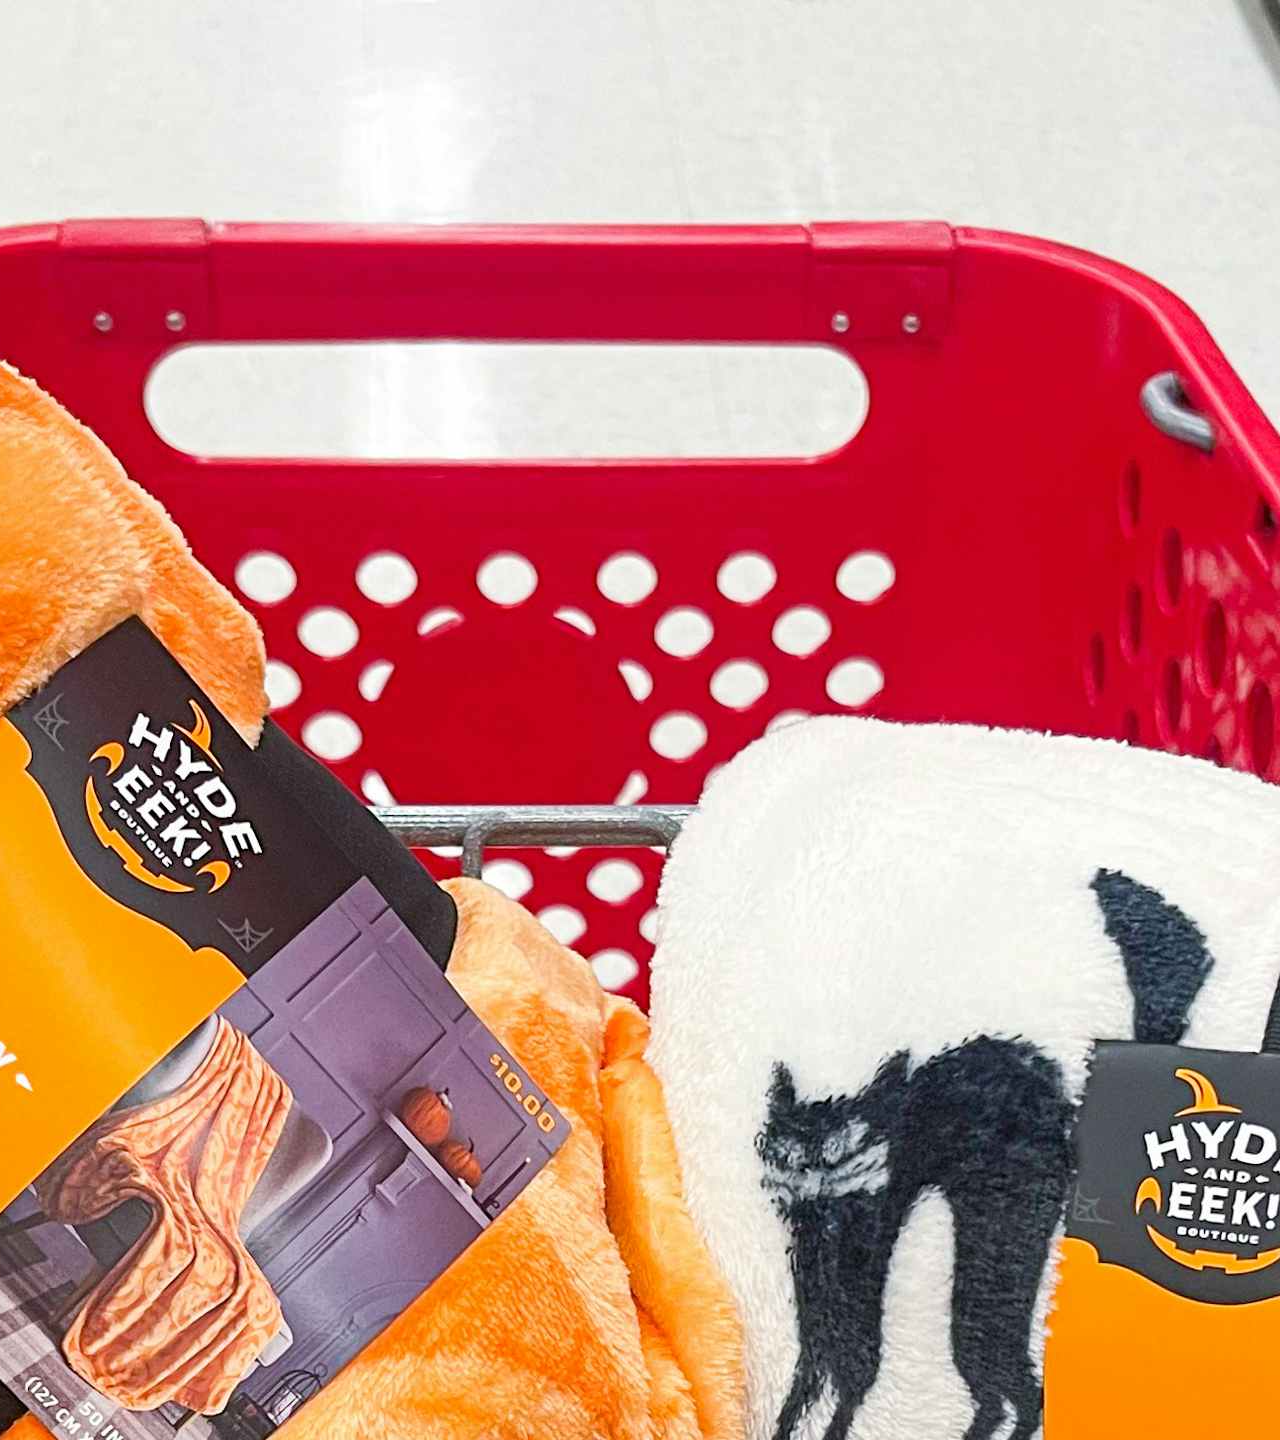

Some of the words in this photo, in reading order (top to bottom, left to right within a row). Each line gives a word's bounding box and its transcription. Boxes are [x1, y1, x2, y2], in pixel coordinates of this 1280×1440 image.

[128, 713, 263, 858] HYDE
[163, 780, 200, 818] AND
[109, 800, 172, 867] BOUTIQUE
[113, 764, 211, 867] EEK!
[490, 1053, 555, 1133] $10.00
[1203, 1167, 1251, 1184] AND
[1167, 1182, 1280, 1230] EEK!
[1177, 1225, 1260, 1245] BOUTIQUE
[24, 1376, 59, 1408] (127
[55, 1408, 81, 1435] CM
[79, 1401, 104, 1426] 50
